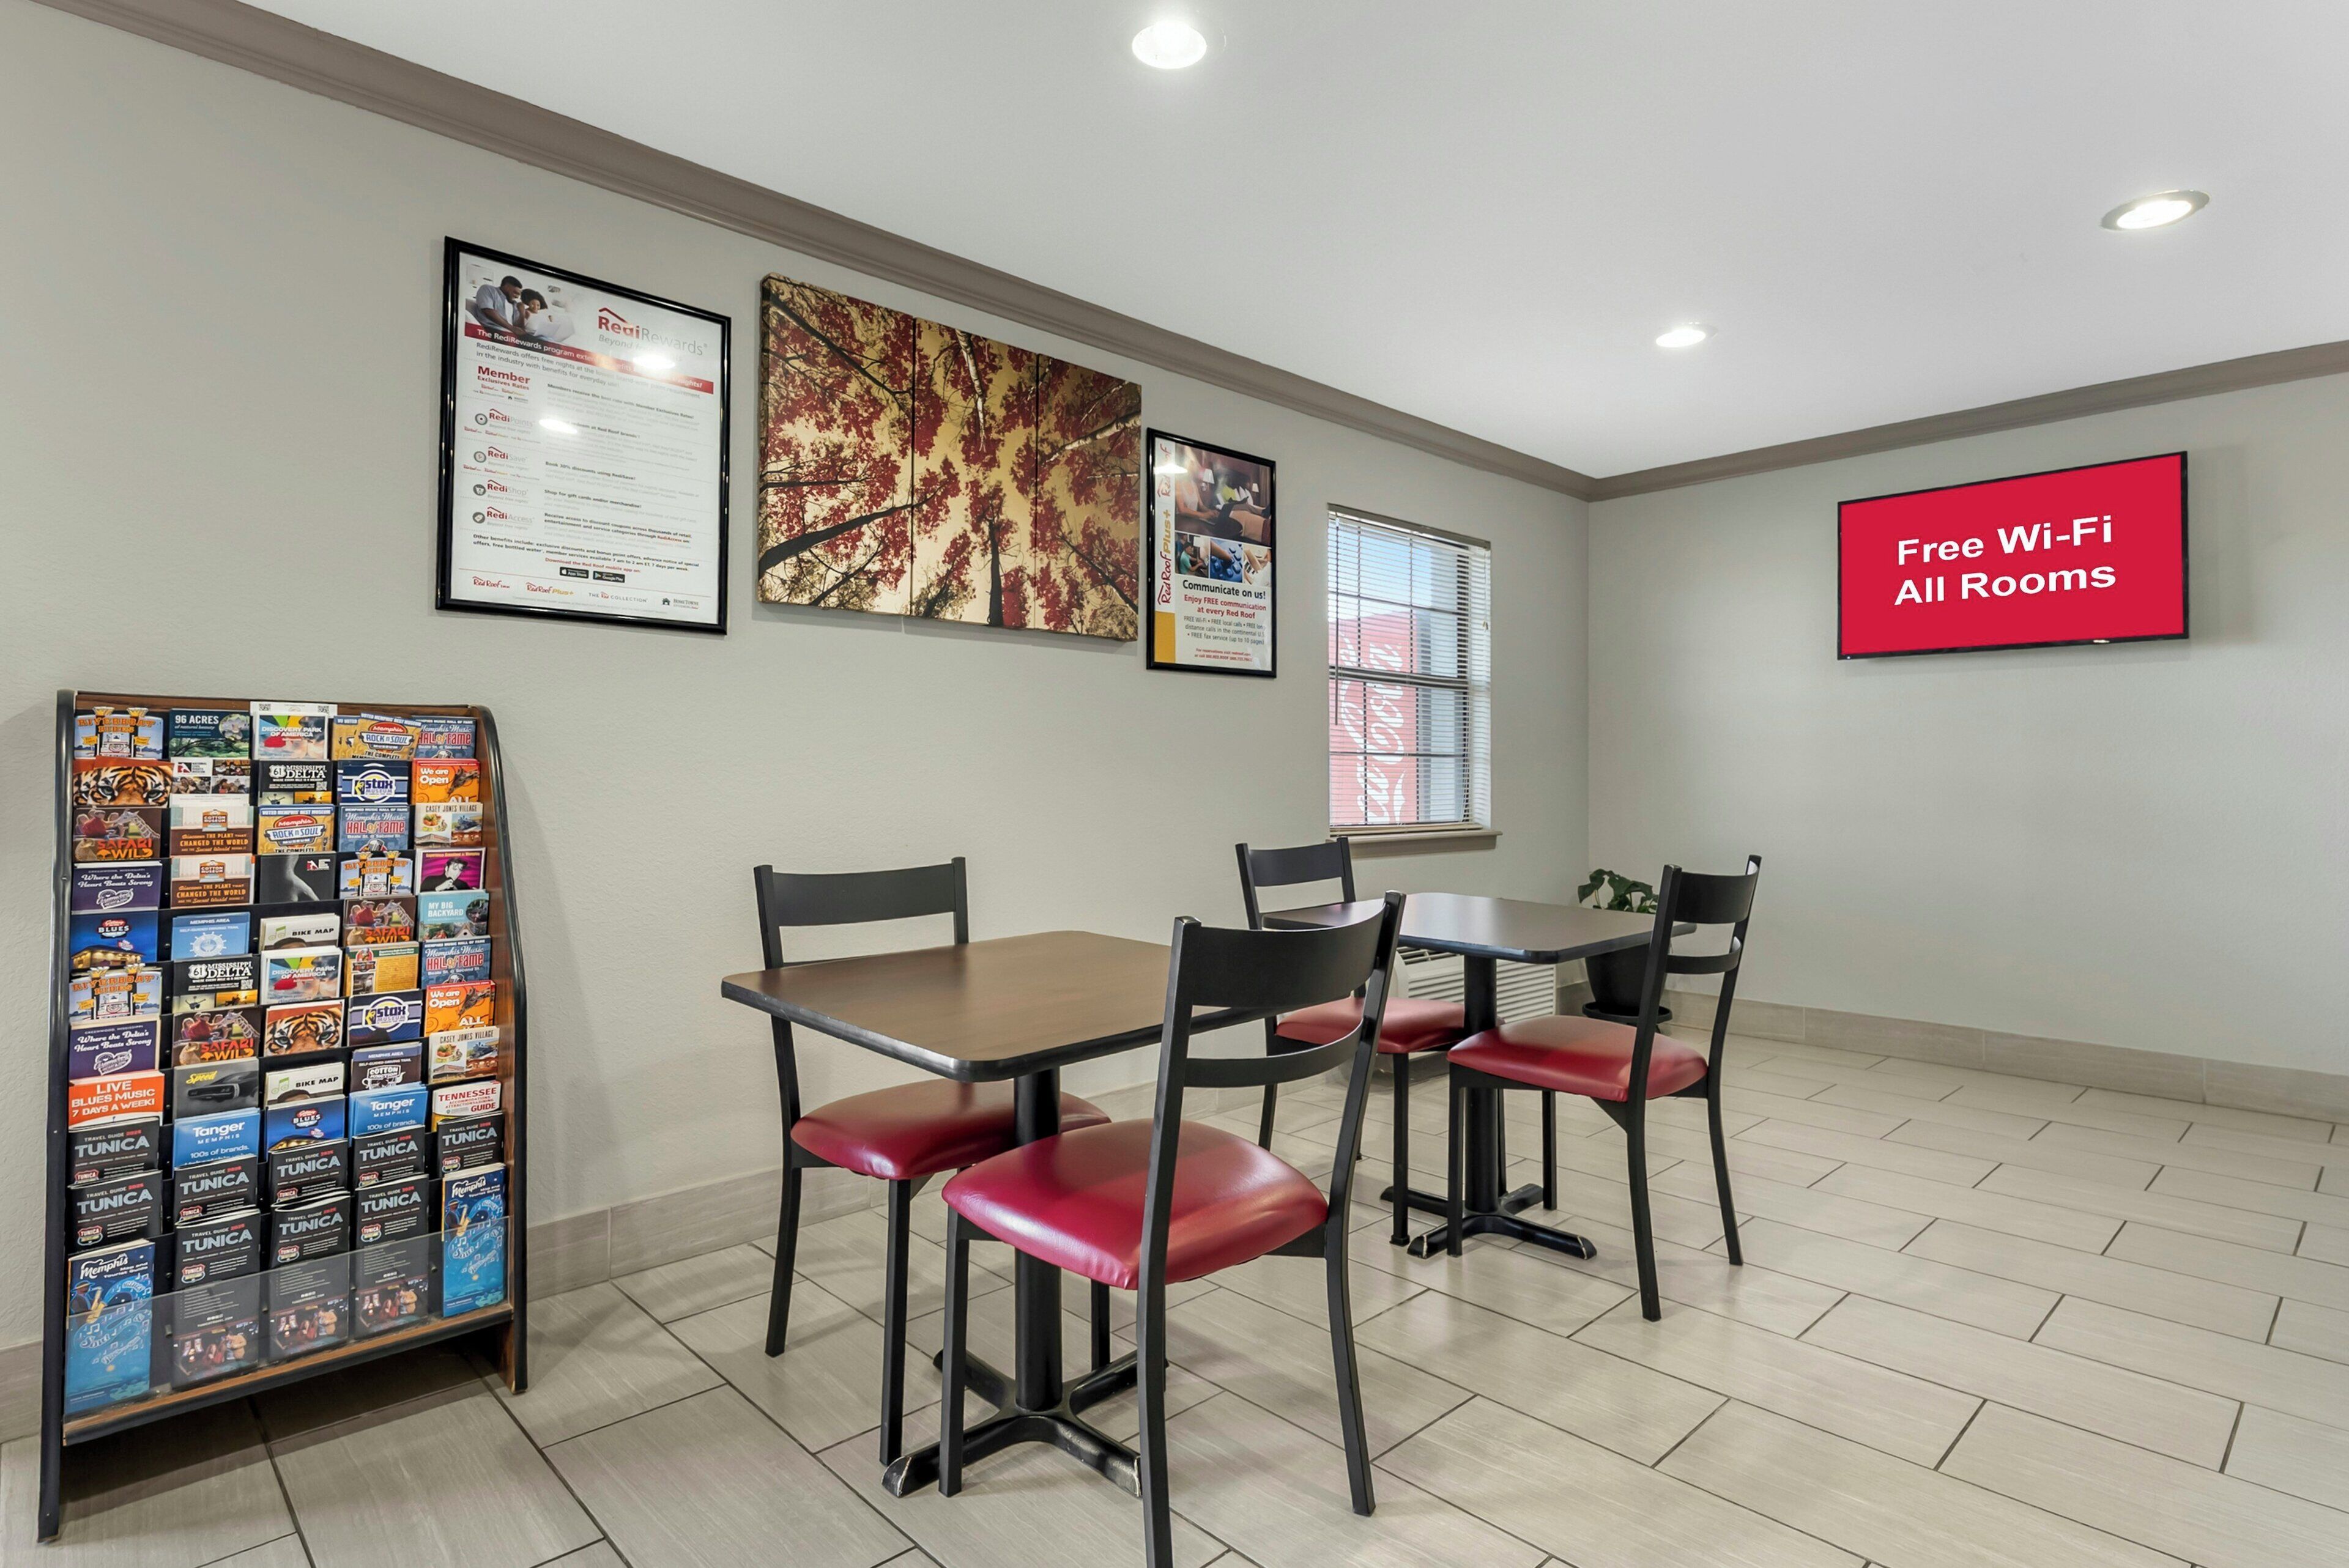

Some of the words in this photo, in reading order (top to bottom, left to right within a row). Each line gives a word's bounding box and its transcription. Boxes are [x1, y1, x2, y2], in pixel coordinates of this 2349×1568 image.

[477, 328, 492, 338] The
[494, 333, 542, 349] RediRewards
[543, 346, 575, 358] program
[477, 342, 519, 357] RediRewards
[521, 352, 540, 361] offers
[555, 361, 575, 369] nights
[477, 365, 530, 384] Member
[498, 355, 525, 367] industry
[542, 366, 568, 377] benefits
[579, 375, 606, 386] everyday
[477, 375, 510, 386] Exclusives
[1898, 538, 1984, 566] Free
[1997, 514, 2113, 554] Wi-Fi
[1160, 551, 1171, 581] Roof
[538, 585, 552, 594] Roof
[1162, 581, 1171, 604] Red
[1182, 580, 1239, 596] Communicate
[1254, 591, 1266, 599] us!
[1894, 575, 1945, 607] All
[1961, 565, 2117, 600] Rooms
[610, 594, 647, 603] COLLECTION
[1184, 594, 1202, 604] Enjoy
[1220, 600, 1266, 610] communication
[1206, 608, 1225, 616] every
[78, 718, 155, 727] RIVERBOAT
[175, 715, 187, 723] 96
[189, 716, 219, 724] ACRES
[366, 779, 393, 789] stax
[420, 775, 450, 785] Open
[345, 812, 380, 822] Memphis
[272, 830, 294, 838] ROCK
[301, 827, 319, 836] SOUL
[346, 821, 367, 834] HALL
[98, 838, 153, 849] SAFARI
[365, 926, 410, 936] SAFARI
[425, 947, 460, 958] Memphis
[207, 967, 252, 978] DELTA
[72, 975, 155, 992] RIVERBOAT
[429, 997, 460, 1008] Open
[377, 1007, 406, 1017] stax
[459, 1016, 484, 1026] ALL
[122, 1030, 149, 1038] Delta's
[440, 1035, 455, 1044] CASEY
[458, 1033, 473, 1041] JONES
[475, 1030, 494, 1039] VILLAGE
[200, 1038, 254, 1052] SAFARI
[186, 1070, 218, 1084] Speed
[97, 1081, 132, 1095] LIVE
[438, 1087, 497, 1101] TENNESSEE
[72, 1095, 112, 1108] BLUES
[115, 1089, 155, 1101] MUSIC
[370, 1098, 415, 1111] Tanger
[82, 1105, 109, 1115] DAYS
[121, 1098, 155, 1109] WEEK!
[373, 1109, 410, 1117] MEMPHIS
[471, 1102, 496, 1112] GUIDE
[293, 1114, 321, 1124] BLUES
[193, 1122, 245, 1137] Tanger
[442, 1127, 497, 1146] TUNICA
[198, 1133, 240, 1144] MEMPHIS
[75, 1136, 150, 1158] TUNICA
[190, 1150, 209, 1159] 100s
[220, 1144, 250, 1154] brands.
[359, 1141, 418, 1162] TUNICA
[277, 1155, 341, 1178] TUNICA
[180, 1171, 250, 1195] TUNICA
[451, 1177, 486, 1198] Memphis
[77, 1189, 154, 1215] TUNICA
[361, 1191, 421, 1213] TUNICA
[279, 1212, 343, 1235] TUNICA
[182, 1229, 253, 1253] TUNICA
[80, 1254, 128, 1279] Memphis
